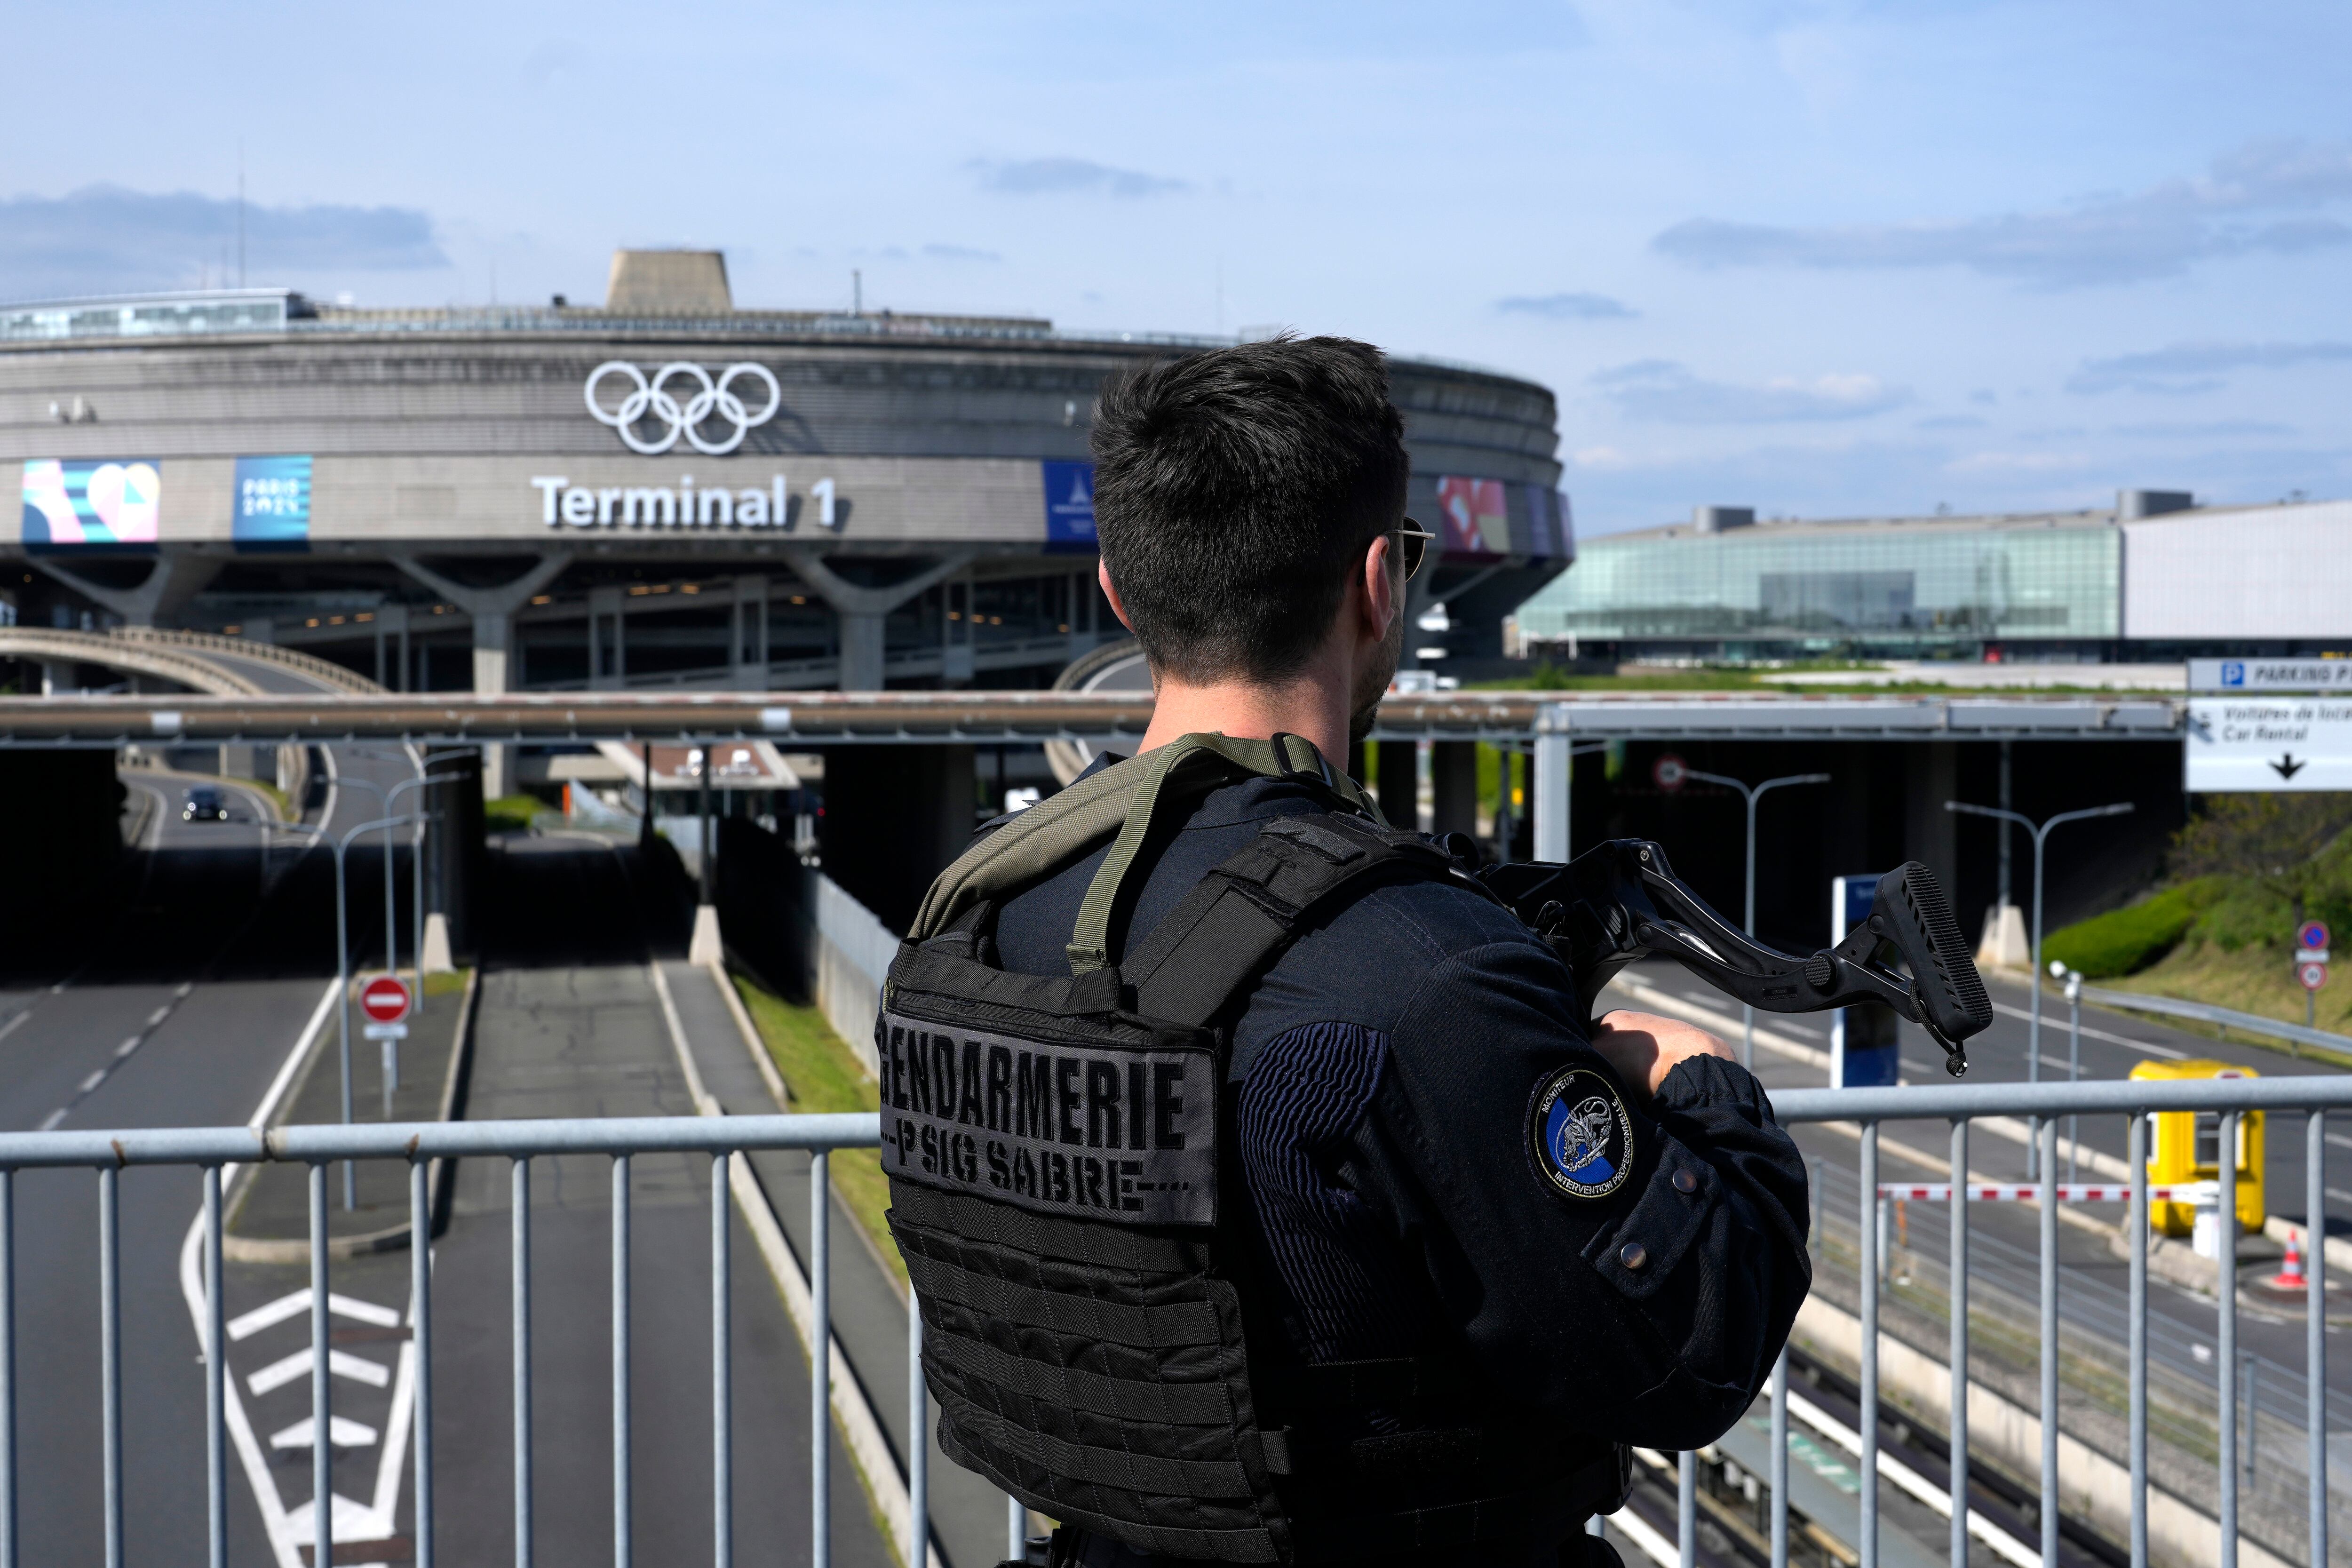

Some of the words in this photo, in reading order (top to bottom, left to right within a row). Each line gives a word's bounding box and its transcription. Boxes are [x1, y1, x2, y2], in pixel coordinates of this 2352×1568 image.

[242, 478, 300, 496] PARIS
[242, 497, 299, 516] 2024
[531, 474, 787, 527] Terminal
[811, 478, 836, 526] 1
[2255, 665, 2331, 681] PARKING
[2225, 706, 2289, 721] Voitures
[2294, 705, 2314, 721] de
[2223, 725, 2250, 742] Car
[2254, 724, 2309, 742] Rental
[1542, 1074, 1575, 1113] MONITEUR
[1554, 1170, 1613, 1194] INTERVENTION
[1612, 1098, 1631, 1186] PROFESSIONNELLE
[896, 1117, 978, 1182] PSIG
[988, 1140, 1144, 1210] SABRE
